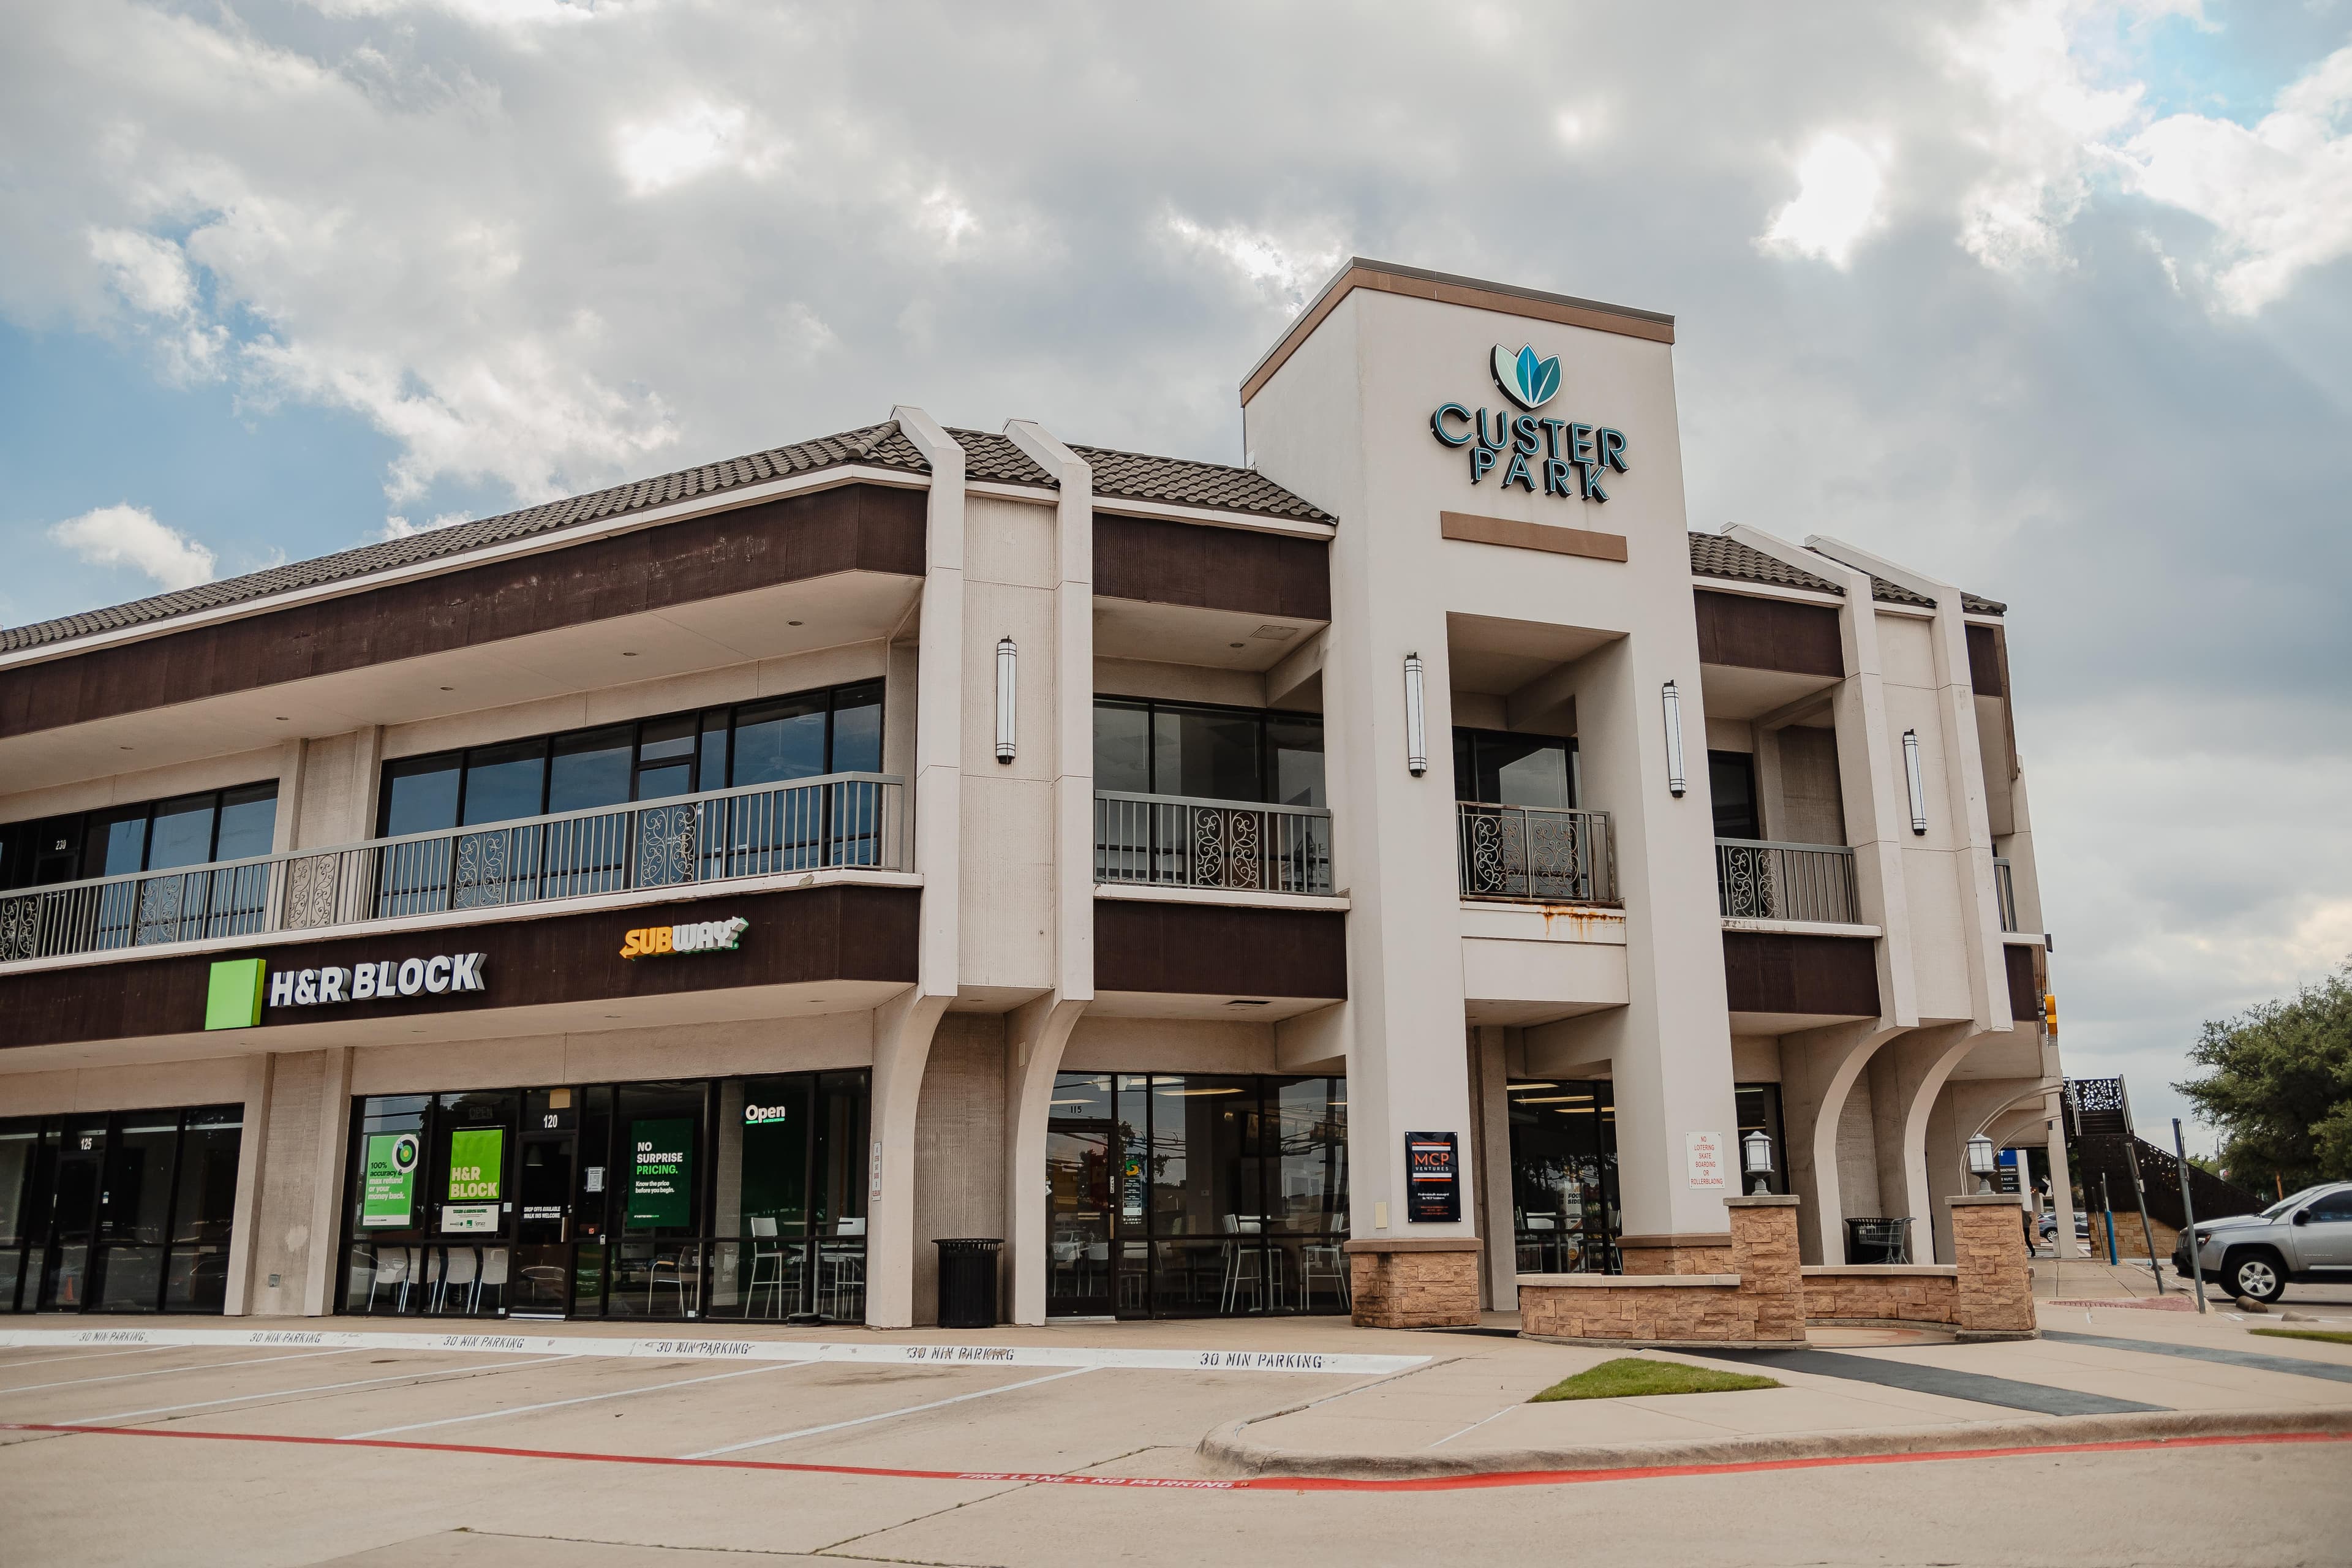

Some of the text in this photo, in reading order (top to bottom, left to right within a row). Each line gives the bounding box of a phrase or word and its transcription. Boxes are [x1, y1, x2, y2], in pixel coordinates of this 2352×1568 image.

[1430, 401, 1630, 473] CUSTER
[1469, 447, 1610, 503] PARK
[619, 916, 750, 960] SUBWAY
[270, 952, 487, 1007] H&R BLOCK
[745, 1104, 785, 1123] Open
[544, 1115, 558, 1128] 120
[81, 1138, 92, 1150] 125
[638, 1142, 652, 1152] NO
[636, 1152, 683, 1163] SURPRISE
[1414, 1152, 1450, 1166] MCP
[451, 1166, 481, 1182] H&R
[636, 1165, 678, 1175] PRICING.
[450, 1182, 498, 1198] BLOCK
[79, 1332, 92, 1341] 30
[109, 1332, 146, 1341] PARKING
[249, 1332, 263, 1342] 30
[282, 1333, 322, 1343] PARKING
[443, 1336, 525, 1348] 30 MIN PARKING
[657, 1342, 673, 1352] 30
[699, 1342, 748, 1354] PARKING
[1200, 1352, 1322, 1368] 30 MIN PARKING
[1129, 1479, 1234, 1488] PARKING
